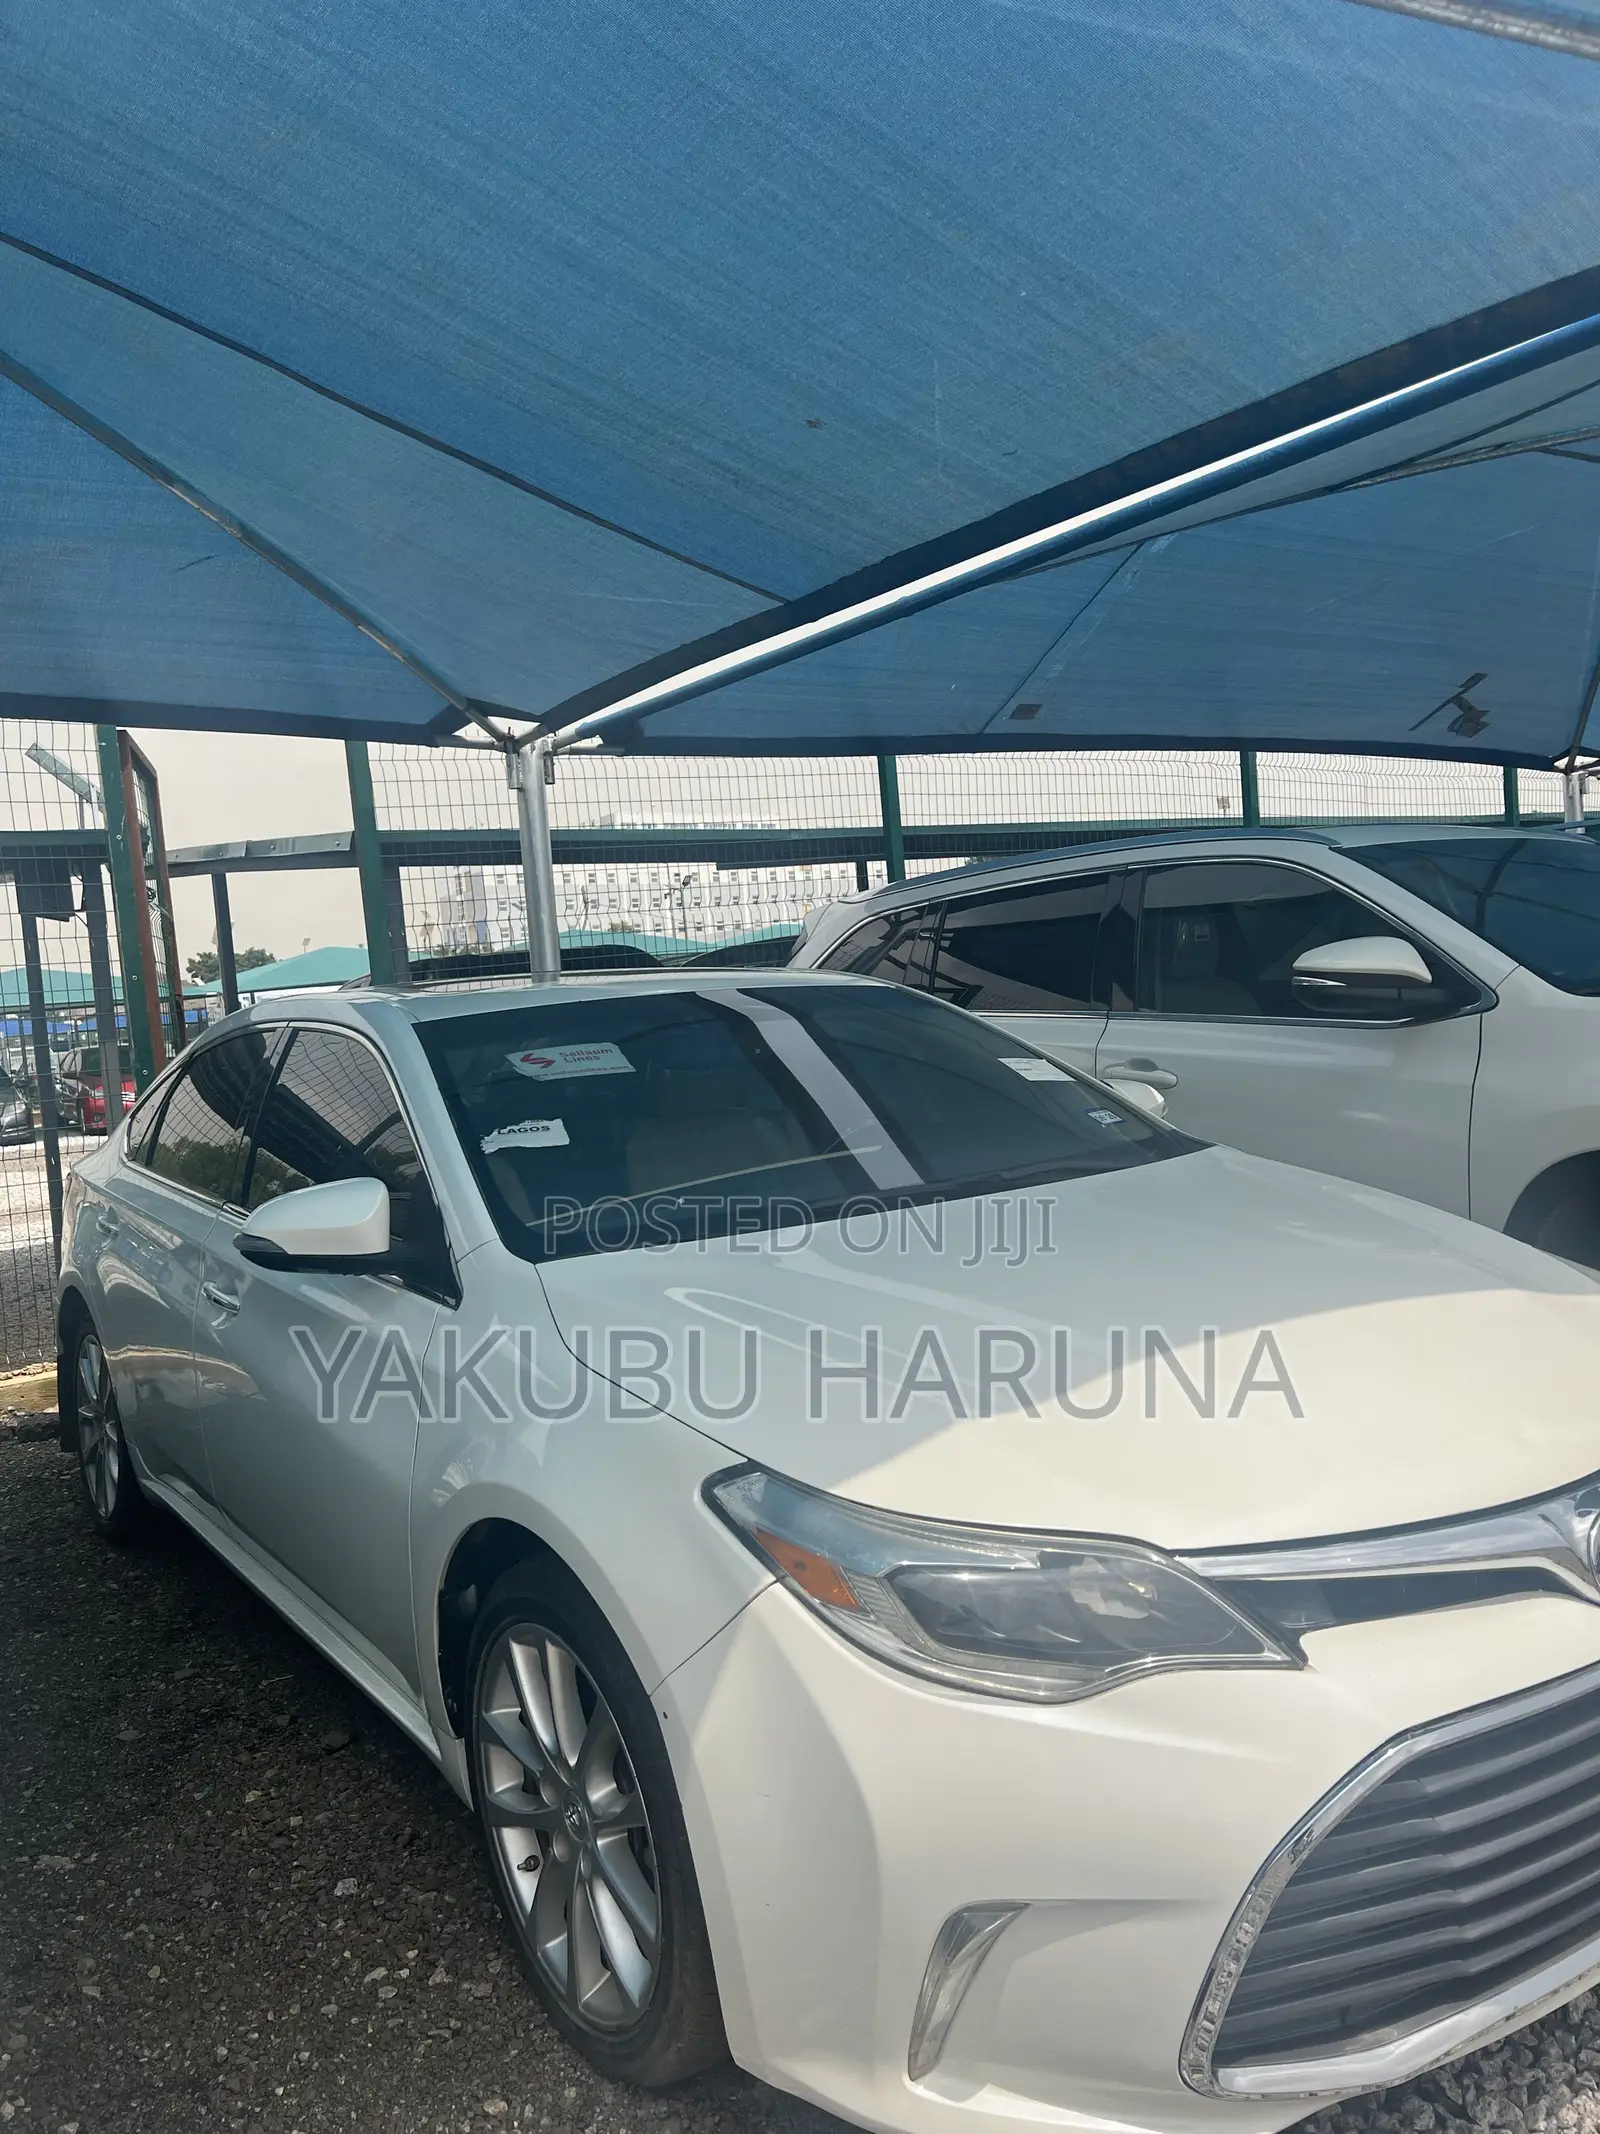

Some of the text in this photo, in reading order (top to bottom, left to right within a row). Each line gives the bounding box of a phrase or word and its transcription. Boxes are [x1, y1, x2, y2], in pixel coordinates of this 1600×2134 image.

[559, 1047, 613, 1058] Sallaum
[563, 1055, 601, 1064] Lines
[497, 1125, 551, 1135] LAGOS
